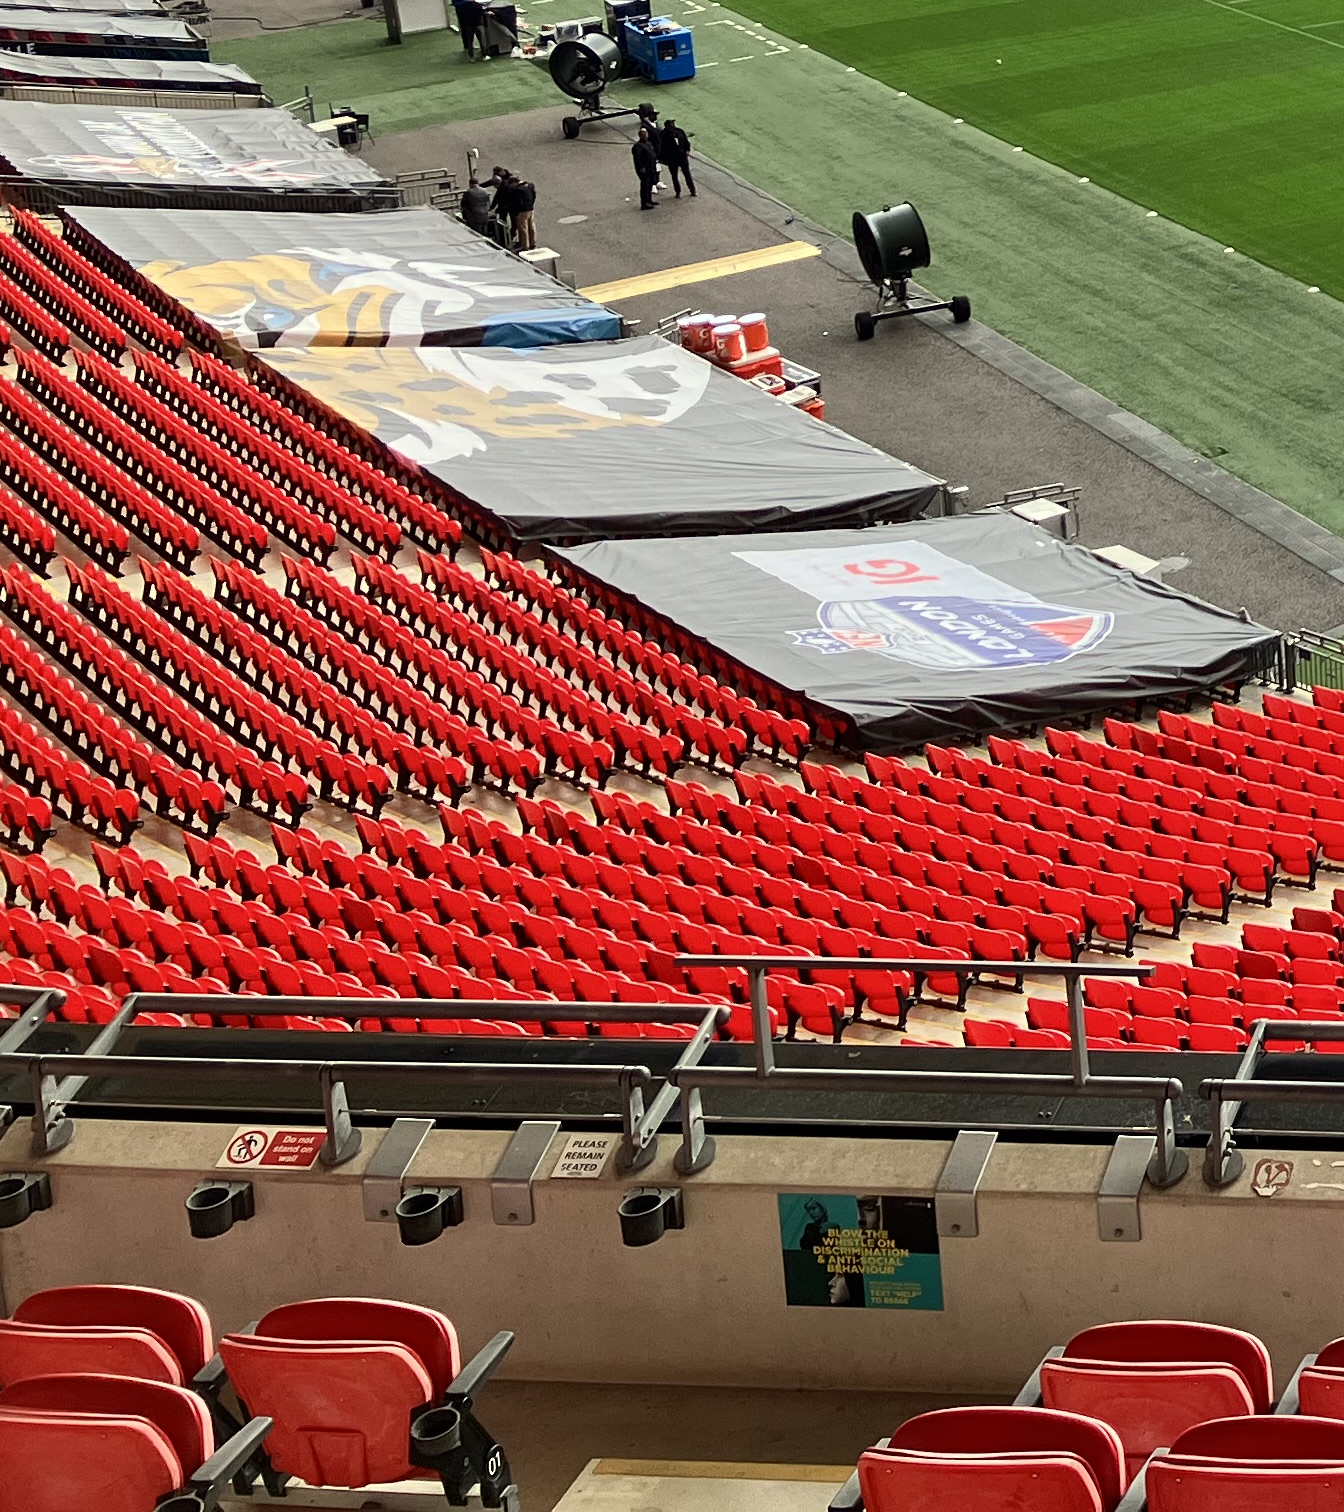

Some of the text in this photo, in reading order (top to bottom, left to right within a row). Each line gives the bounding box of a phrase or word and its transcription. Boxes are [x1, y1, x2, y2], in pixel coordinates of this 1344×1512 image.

[843, 559, 941, 585] IG
[898, 600, 1035, 659] LONDON
[972, 614, 1025, 640] GAMES
[283, 1135, 315, 1144] Do not
[572, 1140, 609, 1148] PLEASE
[272, 1145, 298, 1153] stand
[278, 1154, 298, 1162] wall
[564, 1151, 605, 1159] REMAIN
[561, 1163, 598, 1171] SEATED
[827, 1228, 889, 1239] BLOW THE
[822, 1237, 896, 1248] WHISTLE ON
[813, 1245, 910, 1257] DISCRIMINATION
[817, 1255, 904, 1266] & ANTI-SOCIAL
[827, 1264, 895, 1275] BEHAVIOUR
[488, 1451, 501, 1476] 01
